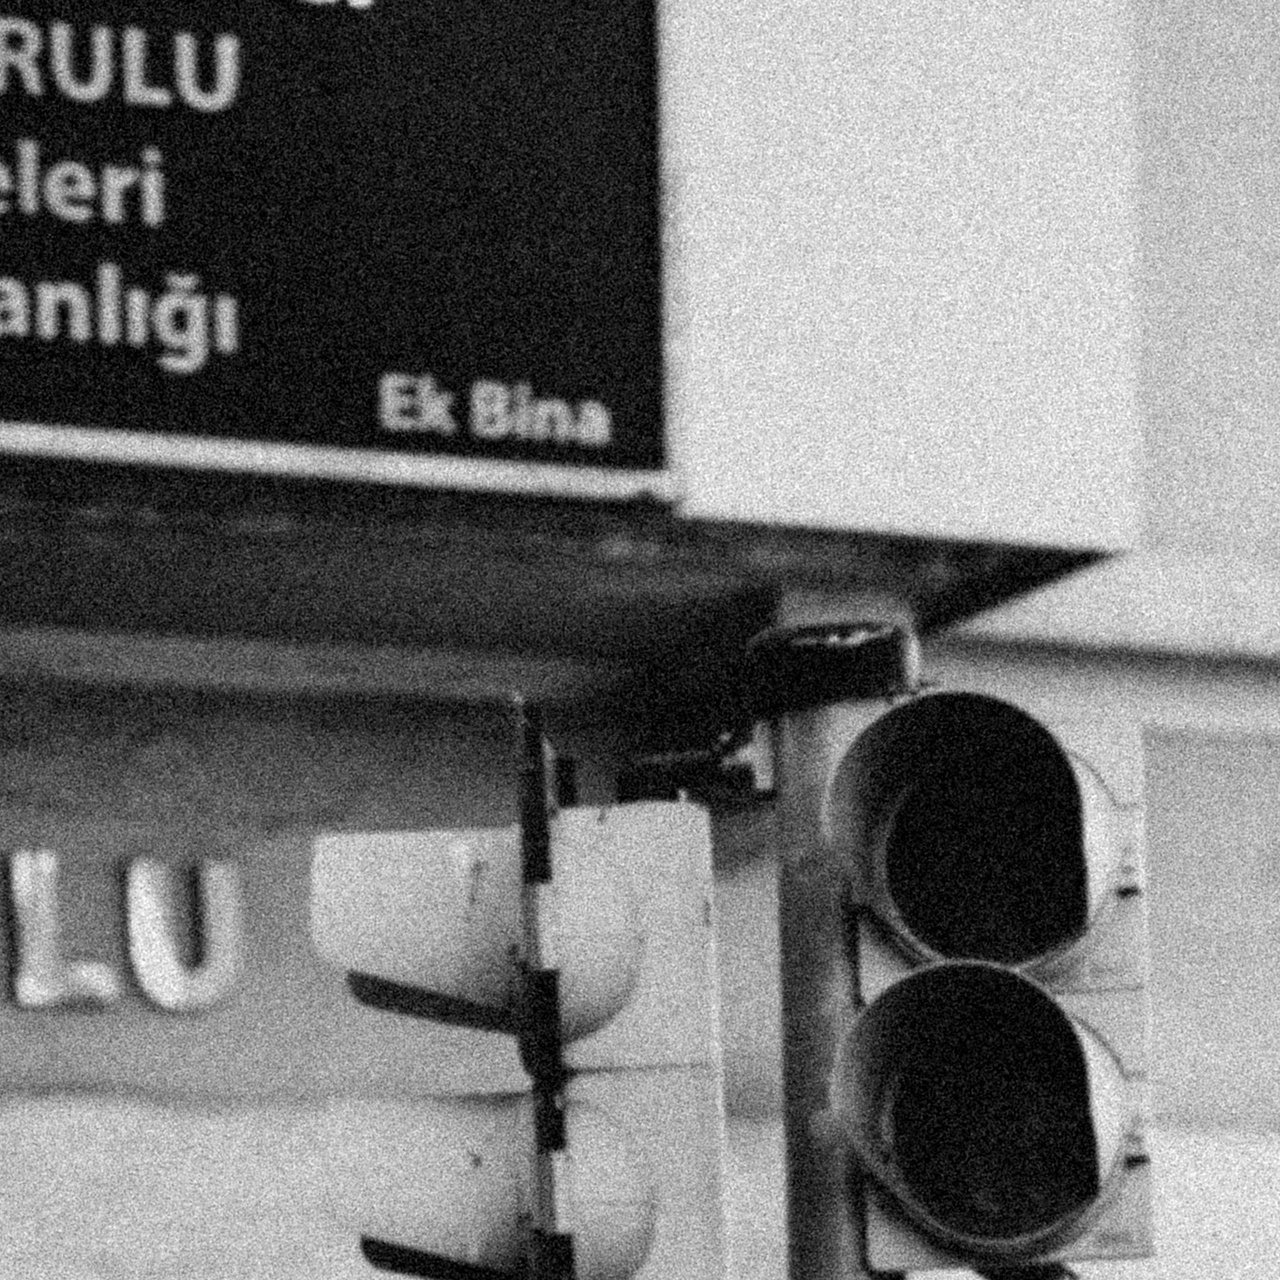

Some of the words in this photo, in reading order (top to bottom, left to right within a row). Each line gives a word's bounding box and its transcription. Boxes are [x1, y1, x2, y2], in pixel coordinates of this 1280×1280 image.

[0, 17, 240, 112] RULU
[0, 138, 165, 228] leri
[379, 372, 456, 434] Ek
[470, 379, 611, 446] Bina
[11, 850, 246, 1010] LU
